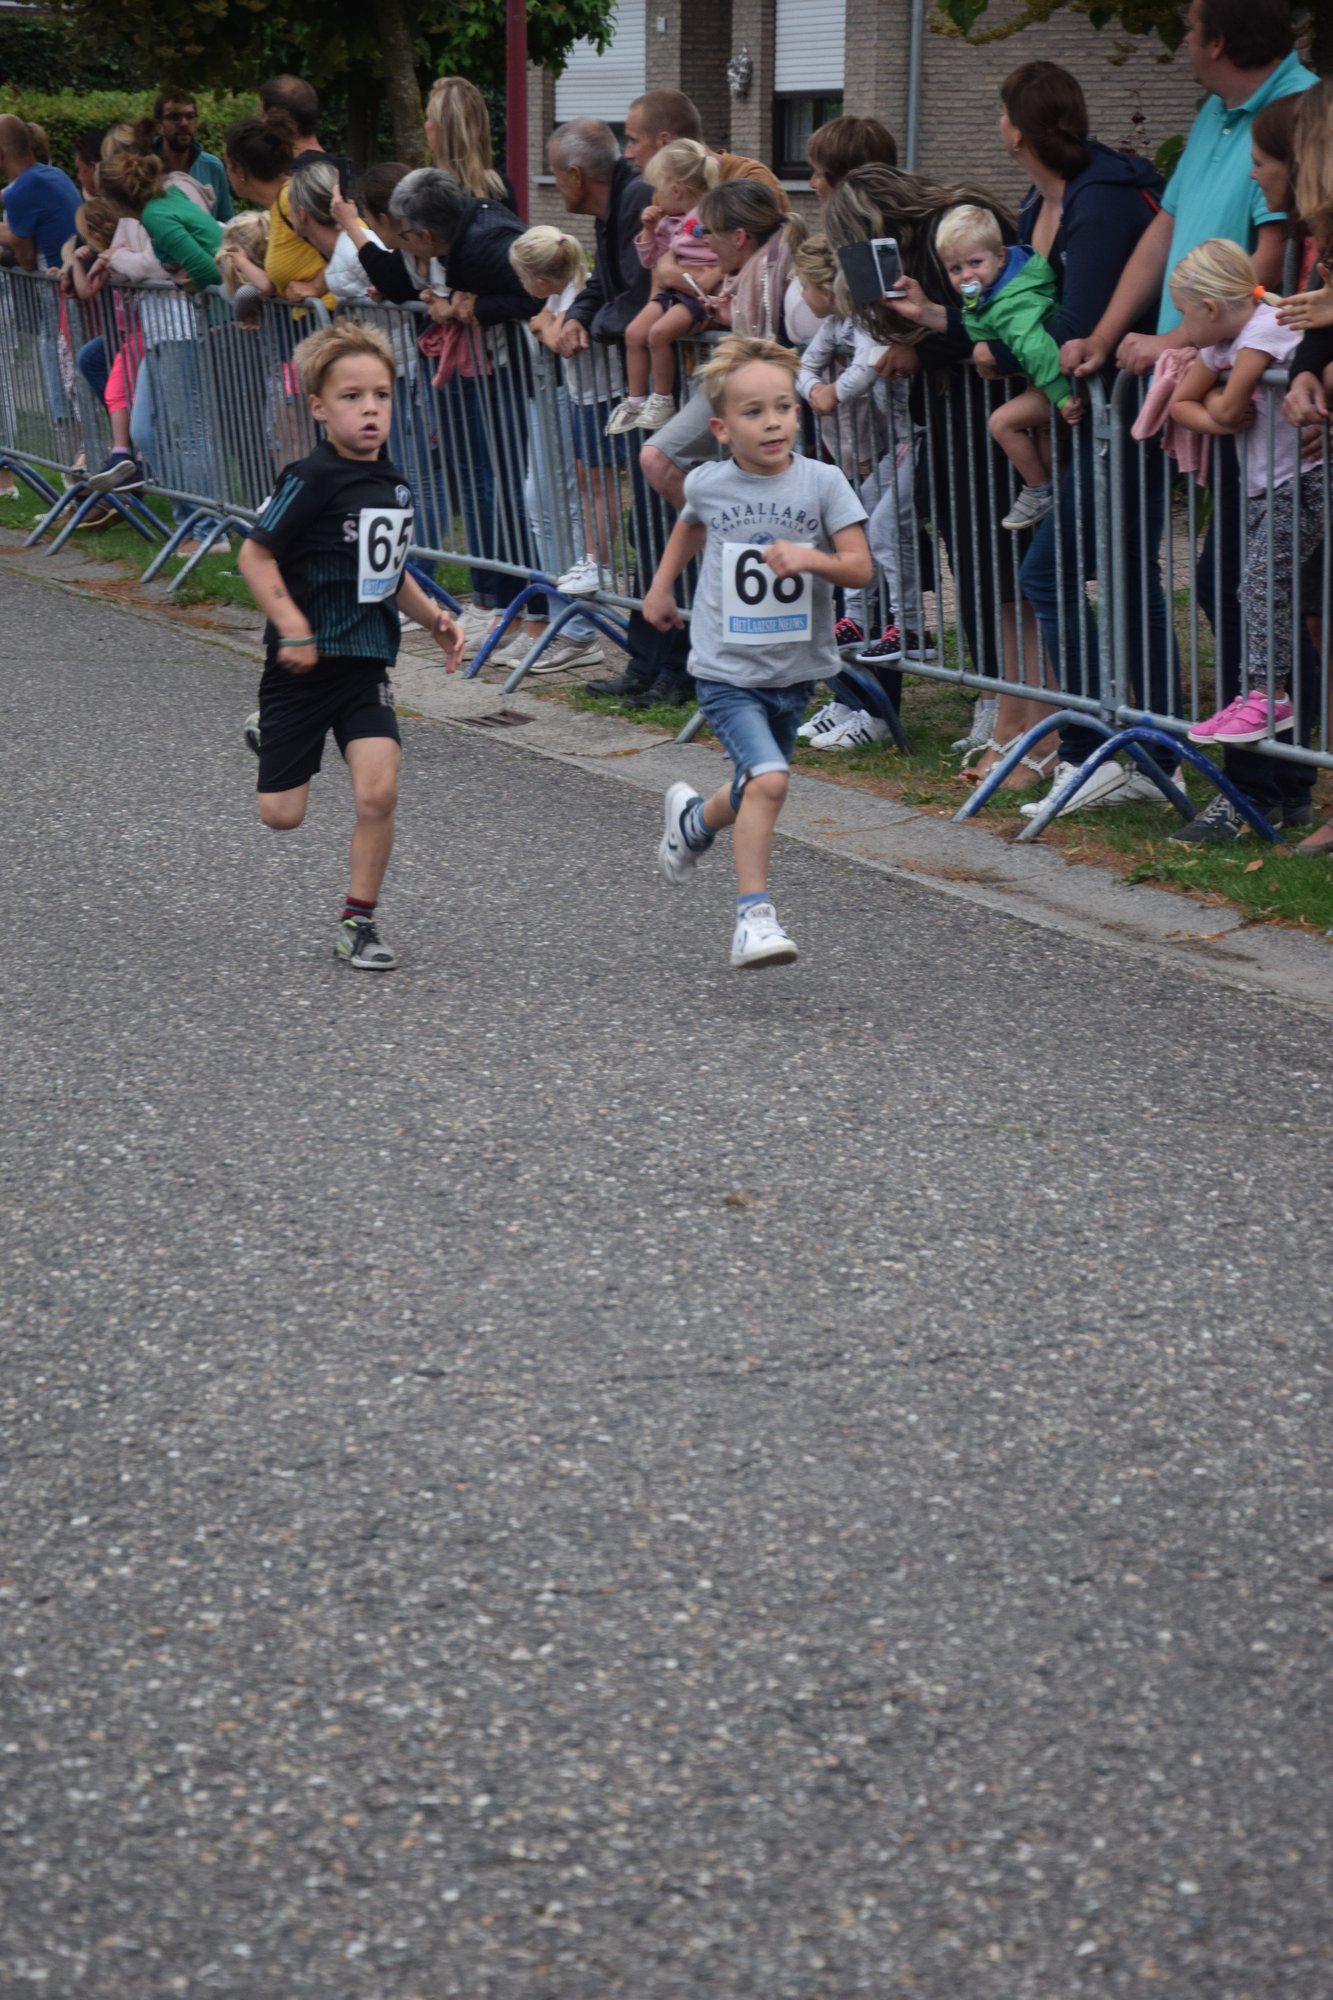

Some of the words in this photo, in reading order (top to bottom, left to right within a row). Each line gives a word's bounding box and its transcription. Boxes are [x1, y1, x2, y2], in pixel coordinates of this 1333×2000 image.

[710, 502, 819, 531] CAVALLARO
[722, 517, 762, 532] NAPOLI
[769, 517, 804, 534] ITALIA
[368, 516, 413, 573] 65
